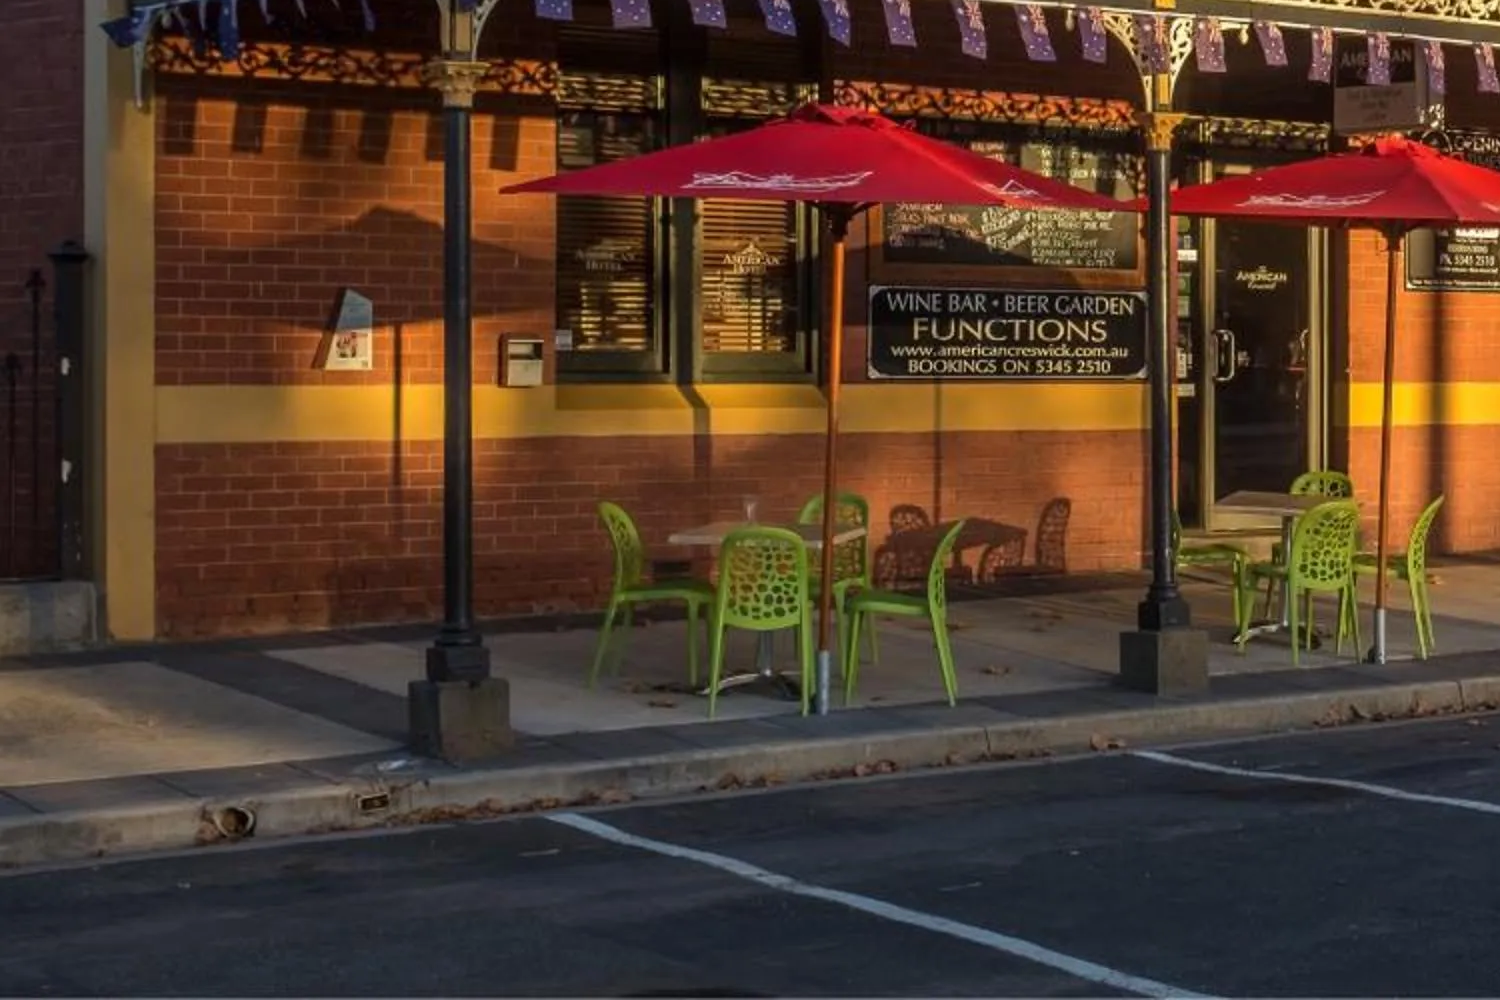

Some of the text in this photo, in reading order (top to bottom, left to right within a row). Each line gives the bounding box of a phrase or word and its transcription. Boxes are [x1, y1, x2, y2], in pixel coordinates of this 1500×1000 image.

[886, 292, 1135, 316] WINE BAR BEER GARDEN
[912, 317, 1108, 343] FUNCTIONS
[890, 343, 1128, 359] www.americancreswick.com.au
[908, 359, 1112, 374] BOOKINGS ON 5345 2510
